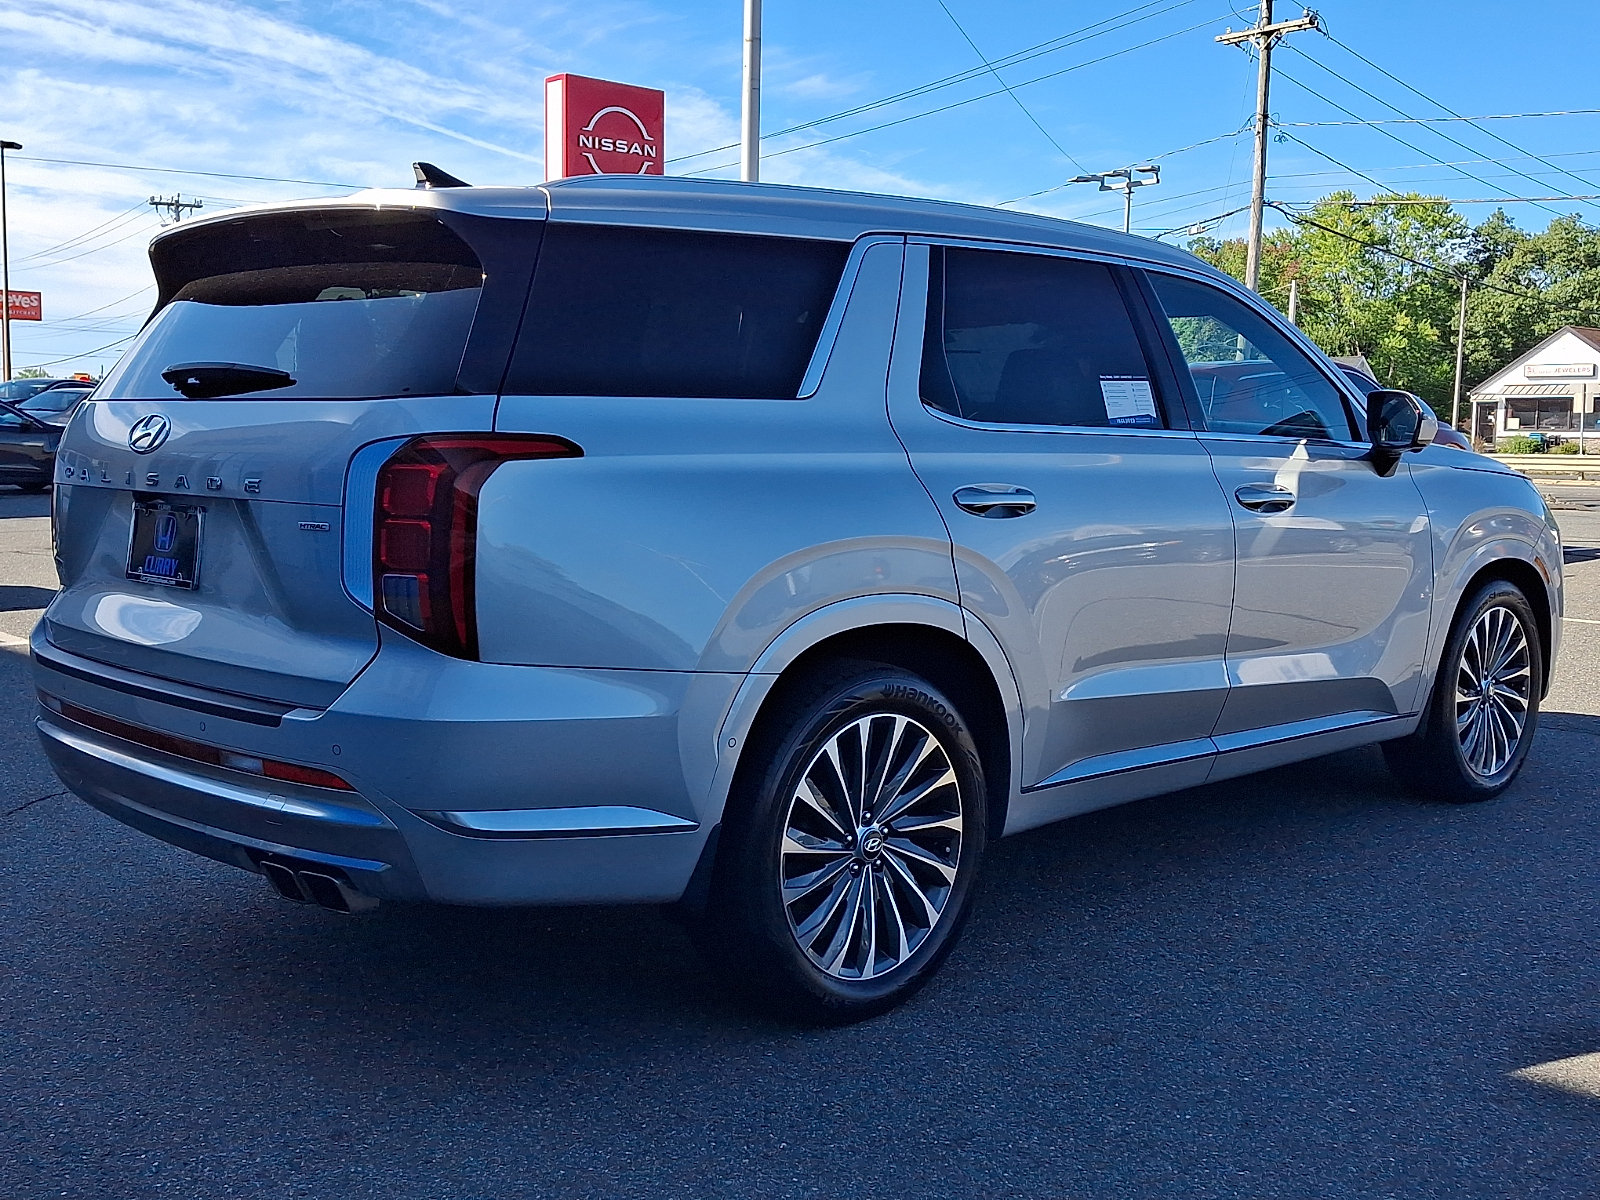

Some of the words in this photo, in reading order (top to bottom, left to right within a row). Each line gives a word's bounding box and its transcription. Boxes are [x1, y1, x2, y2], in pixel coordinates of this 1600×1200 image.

[579, 134, 656, 158] NISSAN
[64, 466, 262, 494] PALISADE
[144, 555, 179, 577] CURRY
